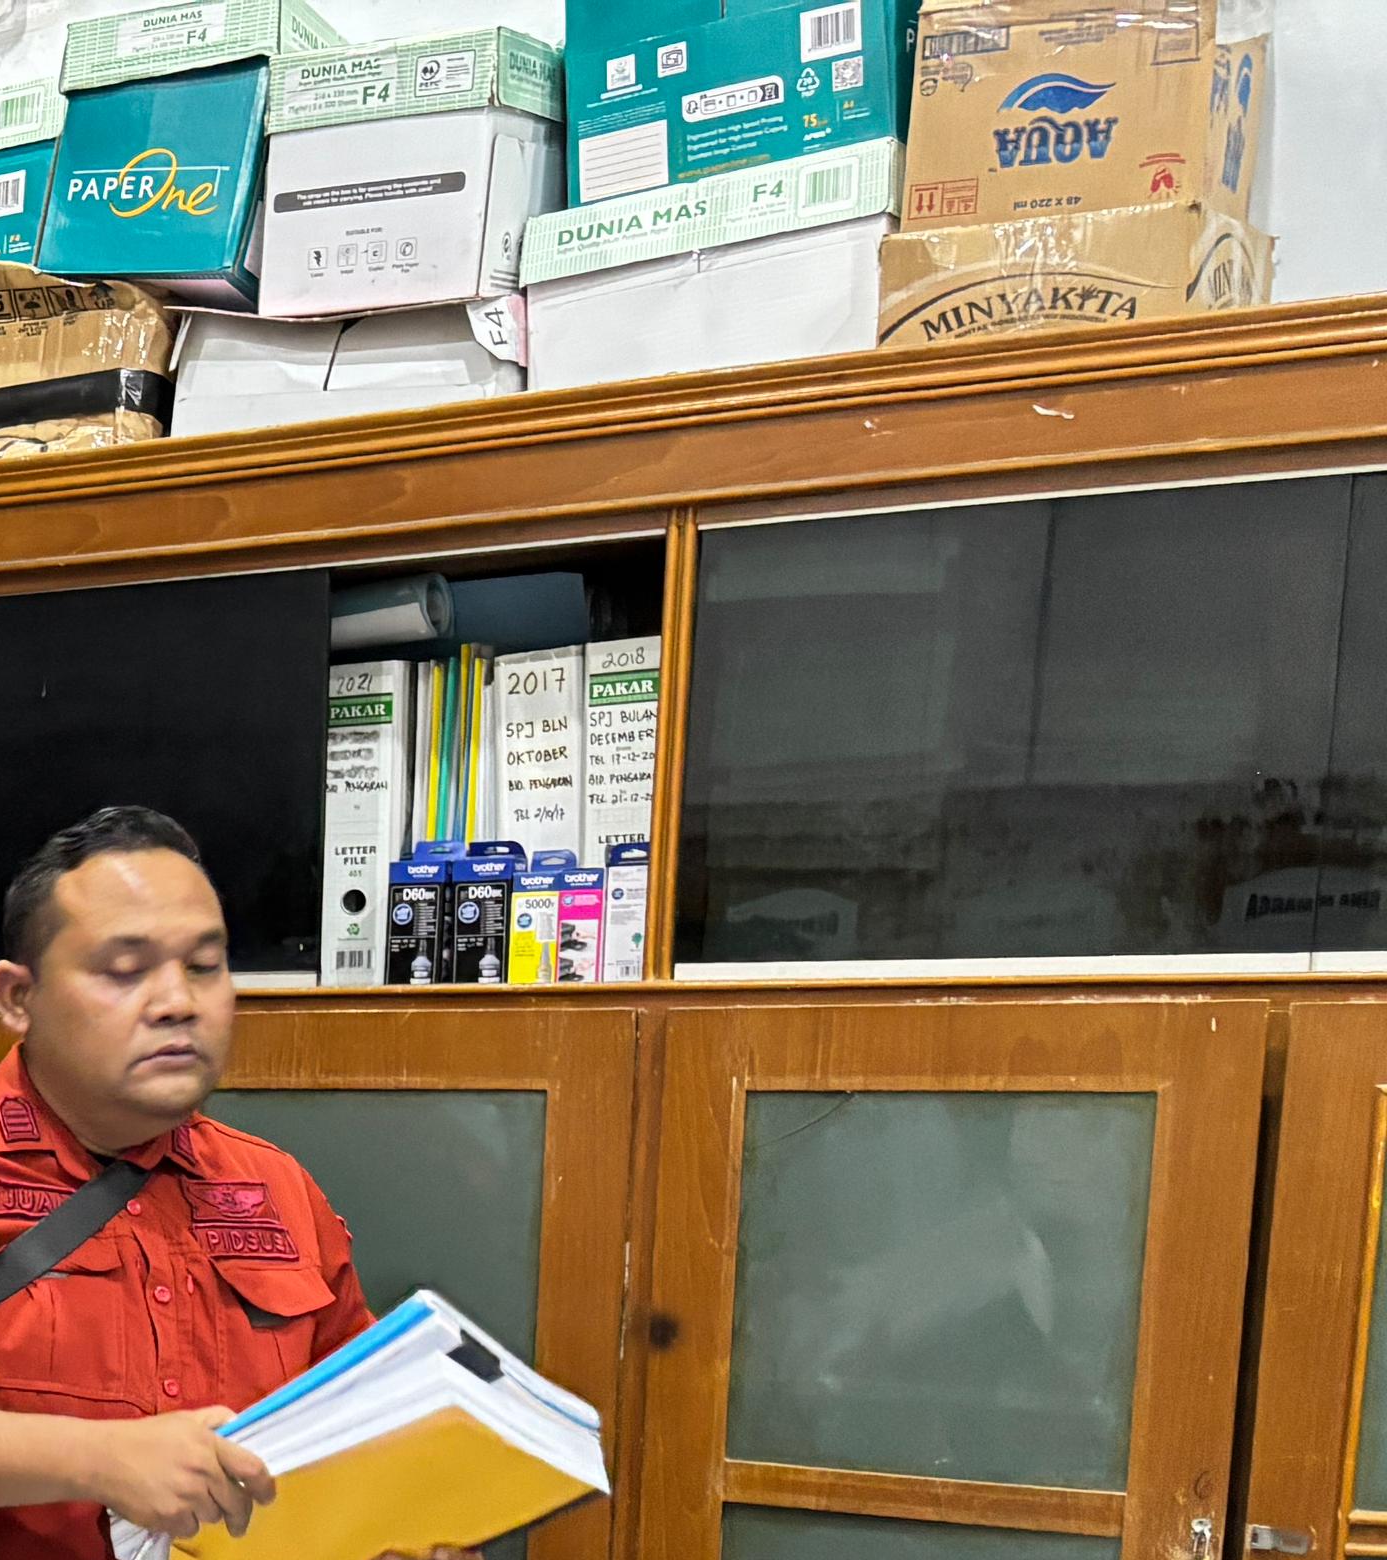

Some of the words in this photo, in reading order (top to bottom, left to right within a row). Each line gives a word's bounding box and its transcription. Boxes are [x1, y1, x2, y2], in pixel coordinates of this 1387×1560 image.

[143, 15, 177, 27] DUNIA
[181, 10, 202, 21] MAS
[187, 28, 207, 44] F4
[301, 63, 347, 79] DUNIA
[363, 82, 390, 105] F4
[992, 115, 1119, 169] AQUA
[753, 184, 784, 202] F4
[1067, 195, 1082, 206] 48
[1013, 201, 1027, 211] ml
[1030, 198, 1052, 209] 220
[557, 215, 643, 246] DUNIA
[652, 200, 707, 226] MAS
[920, 284, 1136, 341] MINYAKITA
[485, 307, 508, 346] F4
[601, 646, 645, 669] 2018
[507, 667, 566, 695] 2017
[592, 680, 654, 698] PAKAR
[330, 703, 386, 719] PAKAR
[589, 711, 612, 727] SPJ
[506, 721, 534, 739] SPJ
[542, 716, 568, 734] BLN
[590, 728, 654, 746] DESEMBER
[507, 746, 568, 766] OKTOBER
[598, 834, 645, 845] LETTER
[334, 845, 377, 856] LETTER
[343, 856, 367, 865] FILE
[472, 862, 506, 873] brother
[407, 864, 439, 875] brother
[520, 876, 555, 886] brother
[564, 873, 599, 883] brother
[207, 1230, 286, 1251] PIDSUS
